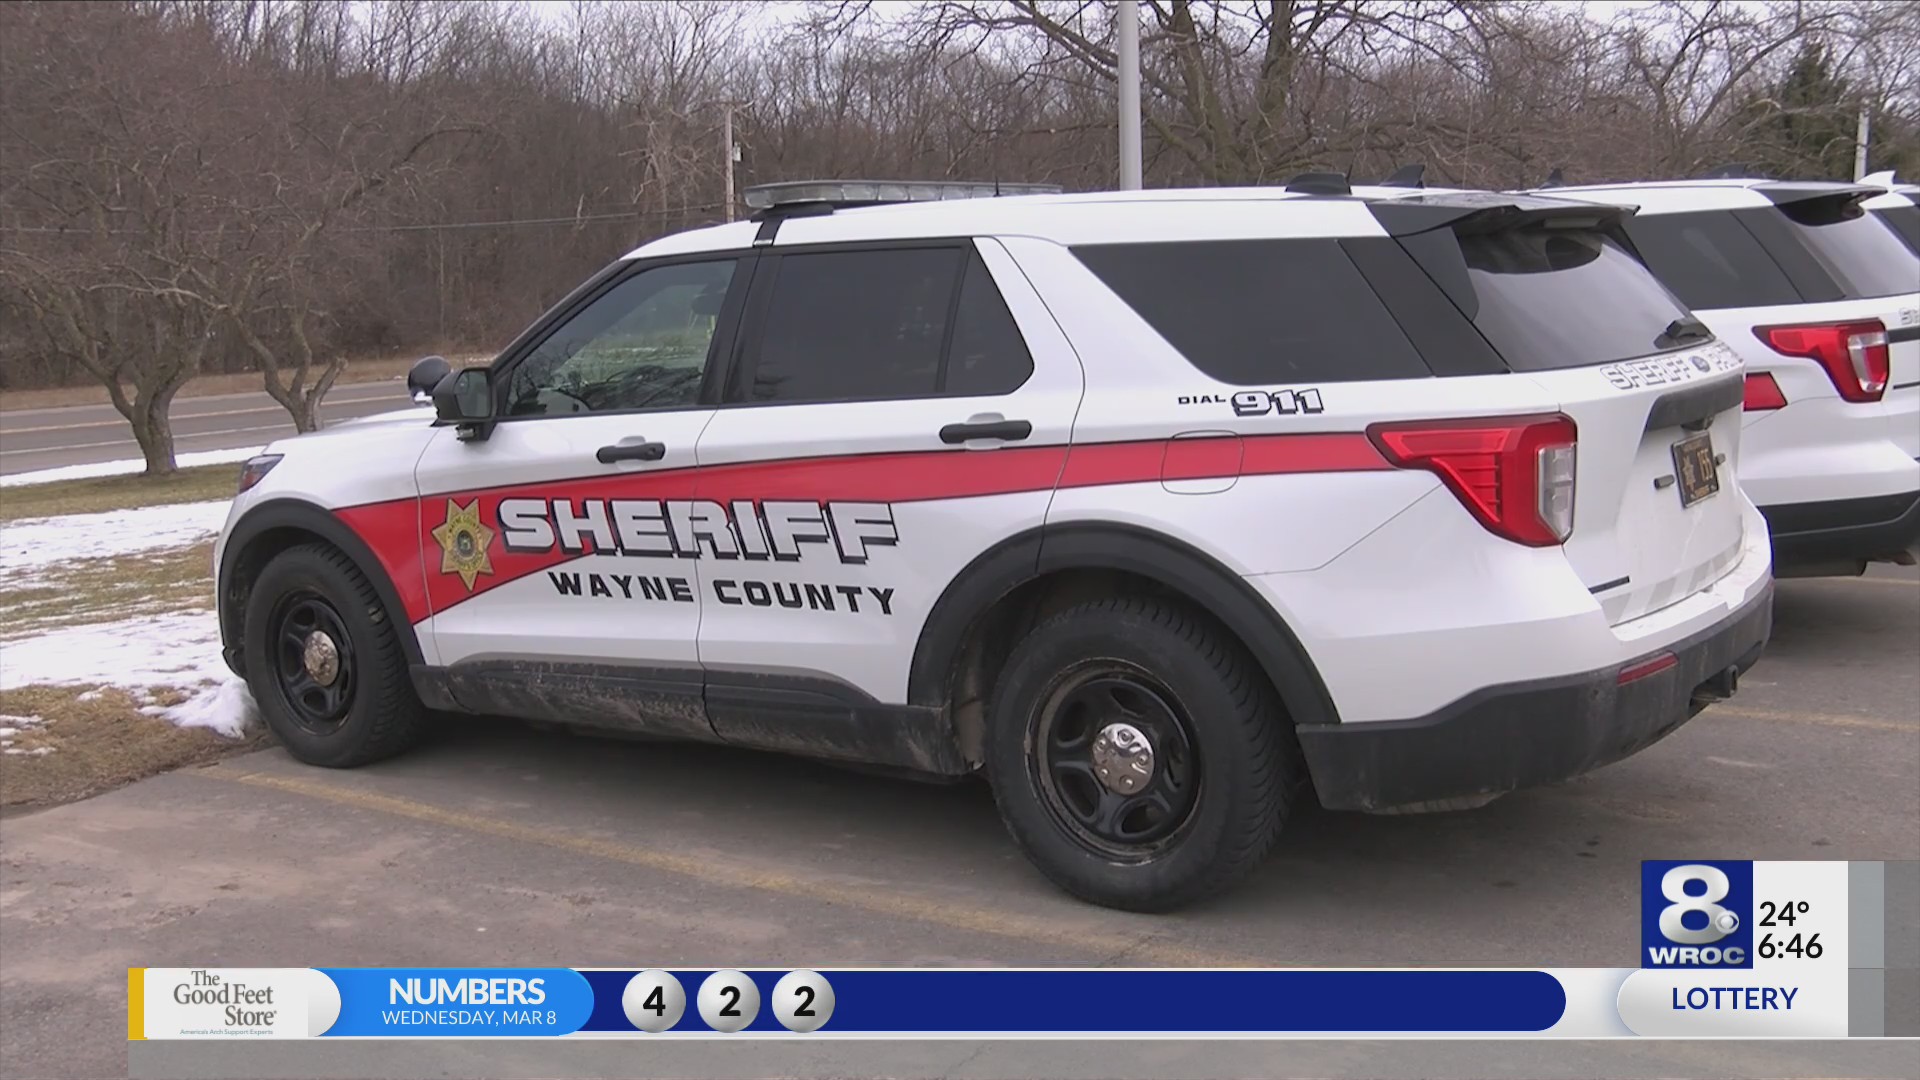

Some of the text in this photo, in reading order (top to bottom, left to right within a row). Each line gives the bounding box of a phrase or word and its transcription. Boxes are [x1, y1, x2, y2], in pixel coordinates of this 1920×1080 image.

[1600, 356, 1691, 390] SHERIFF
[1178, 388, 1324, 417] DIAL 911
[498, 498, 899, 564] SHERIFF
[548, 572, 895, 615] WAYNE COUNTY
